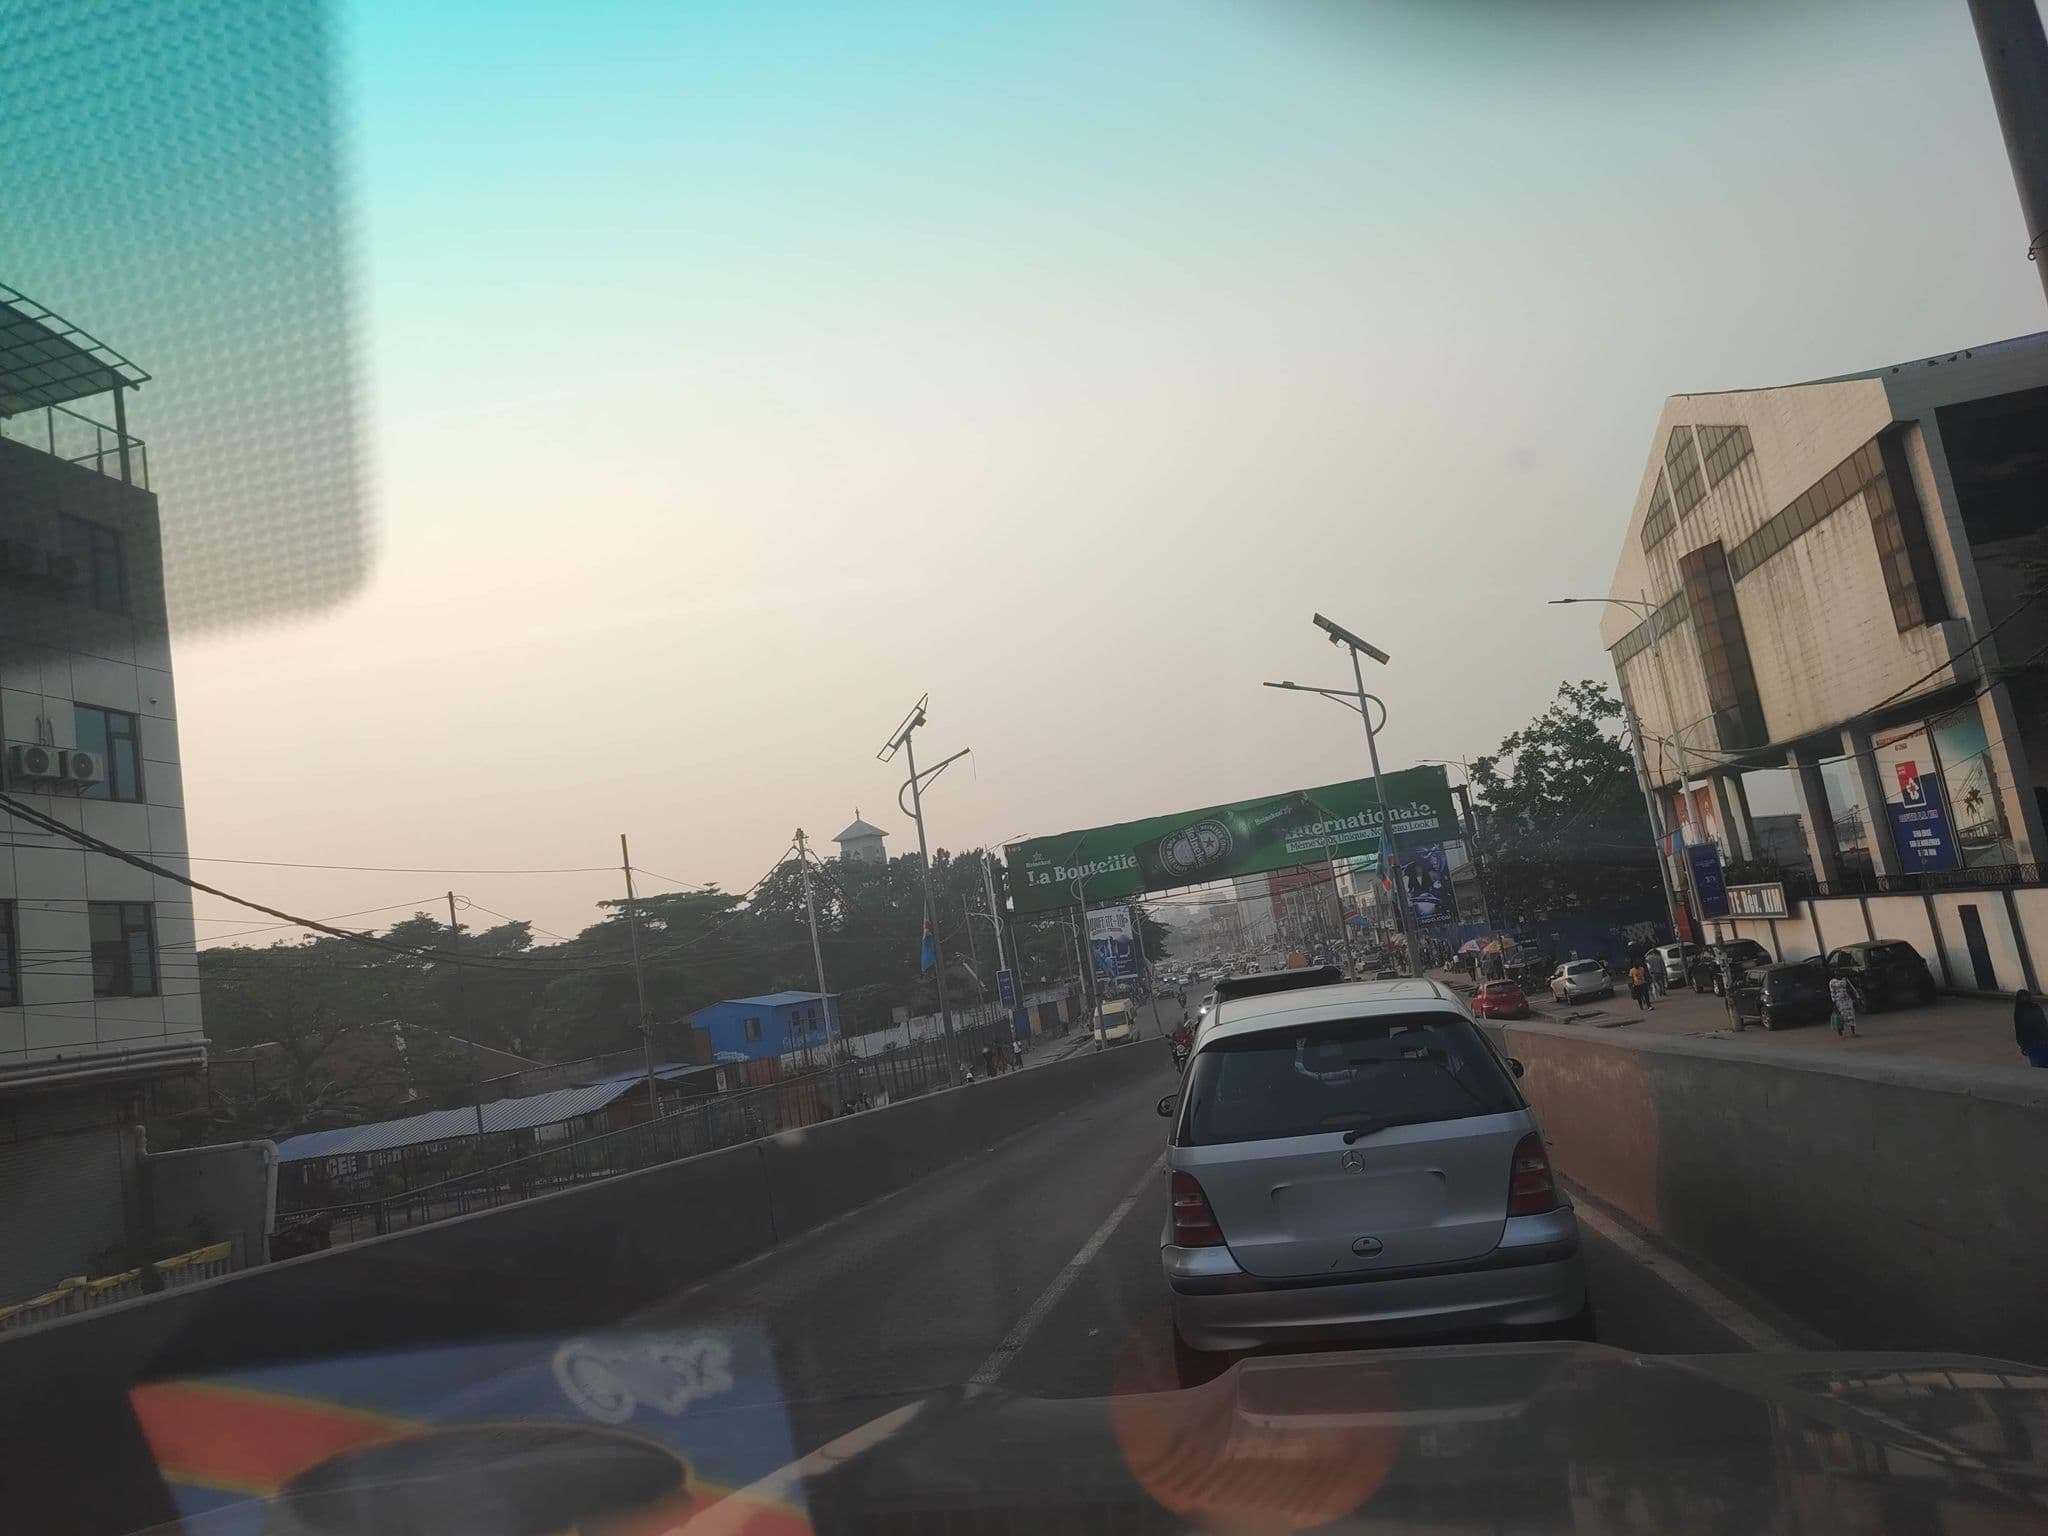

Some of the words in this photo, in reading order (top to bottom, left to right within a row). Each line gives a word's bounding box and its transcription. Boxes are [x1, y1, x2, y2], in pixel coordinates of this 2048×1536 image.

[1368, 824, 1408, 838] Noeau
[1026, 871, 1051, 886] La
[1053, 854, 1138, 882] Bouteille
